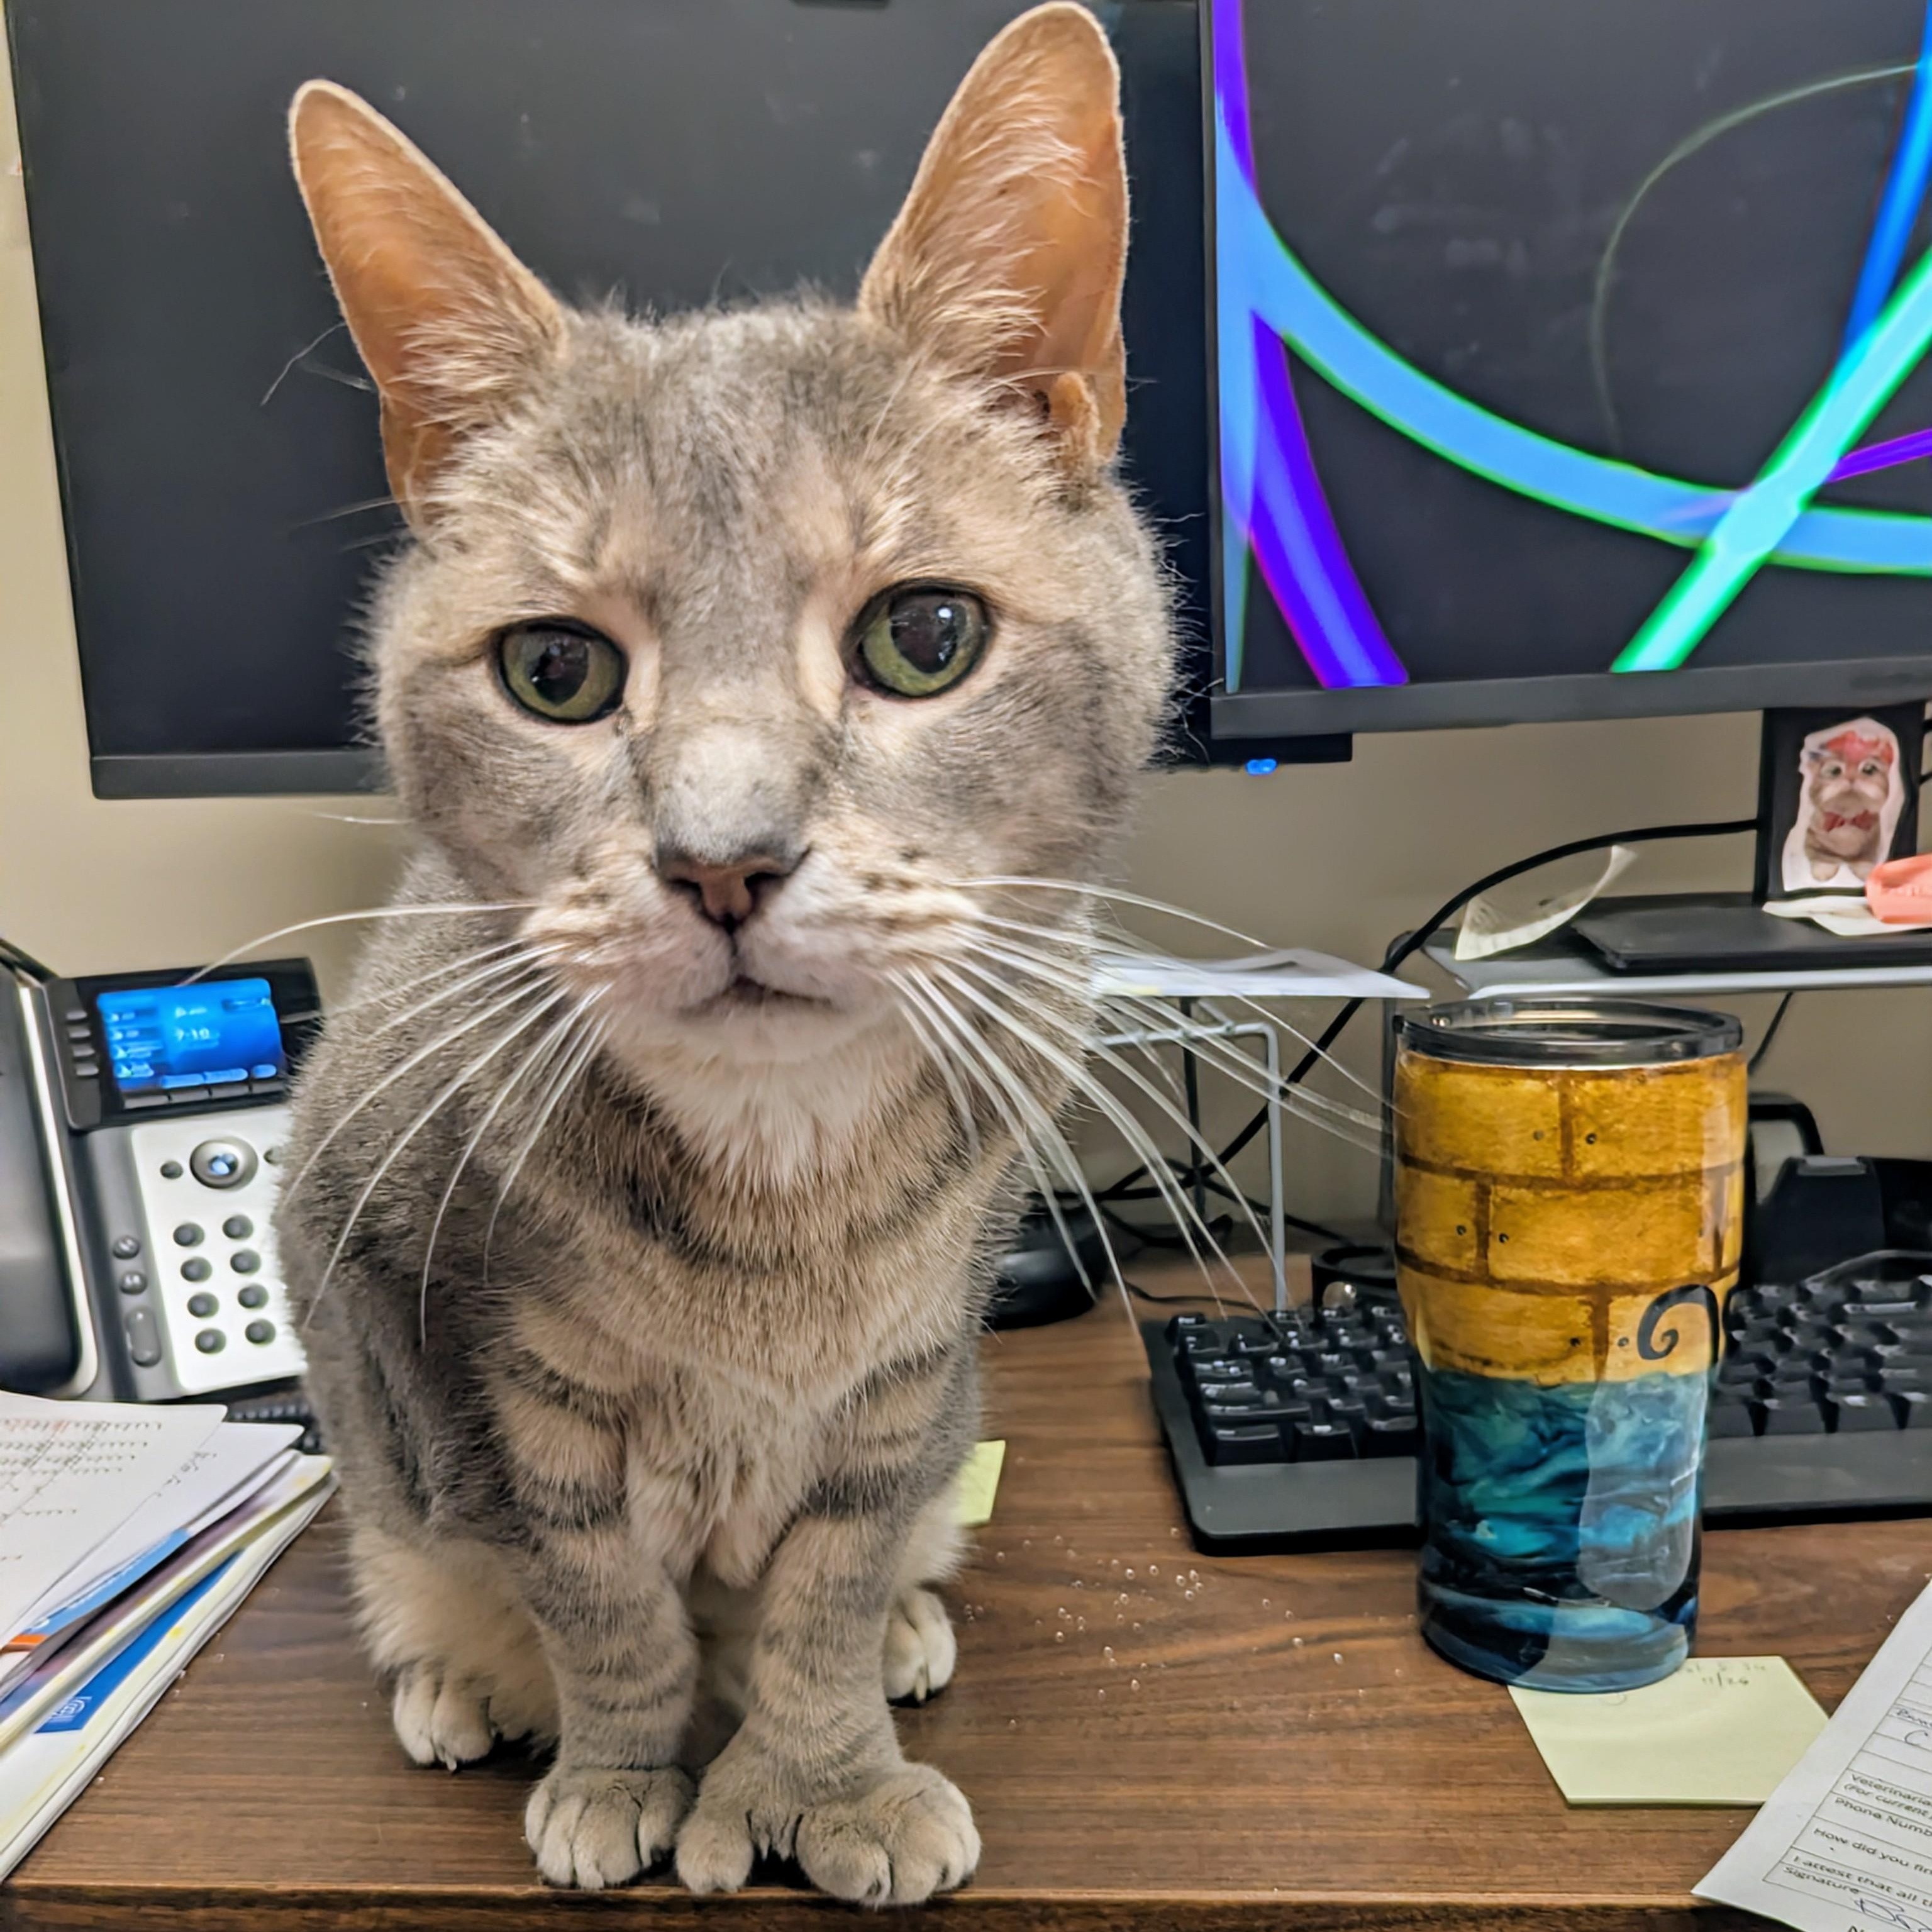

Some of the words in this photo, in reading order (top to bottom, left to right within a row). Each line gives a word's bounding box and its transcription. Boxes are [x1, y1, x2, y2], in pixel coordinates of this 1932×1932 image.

[1835, 1797, 1882, 1819] Phone
[1813, 1828, 1848, 1844] How
[1852, 1841, 1877, 1855] did
[1878, 1852, 1909, 1867] you
[1783, 1866, 1860, 1894] Signature
[1802, 1860, 1852, 1879] attest
[1857, 1873, 1892, 1893] that
[1896, 1891, 1917, 1901] all
